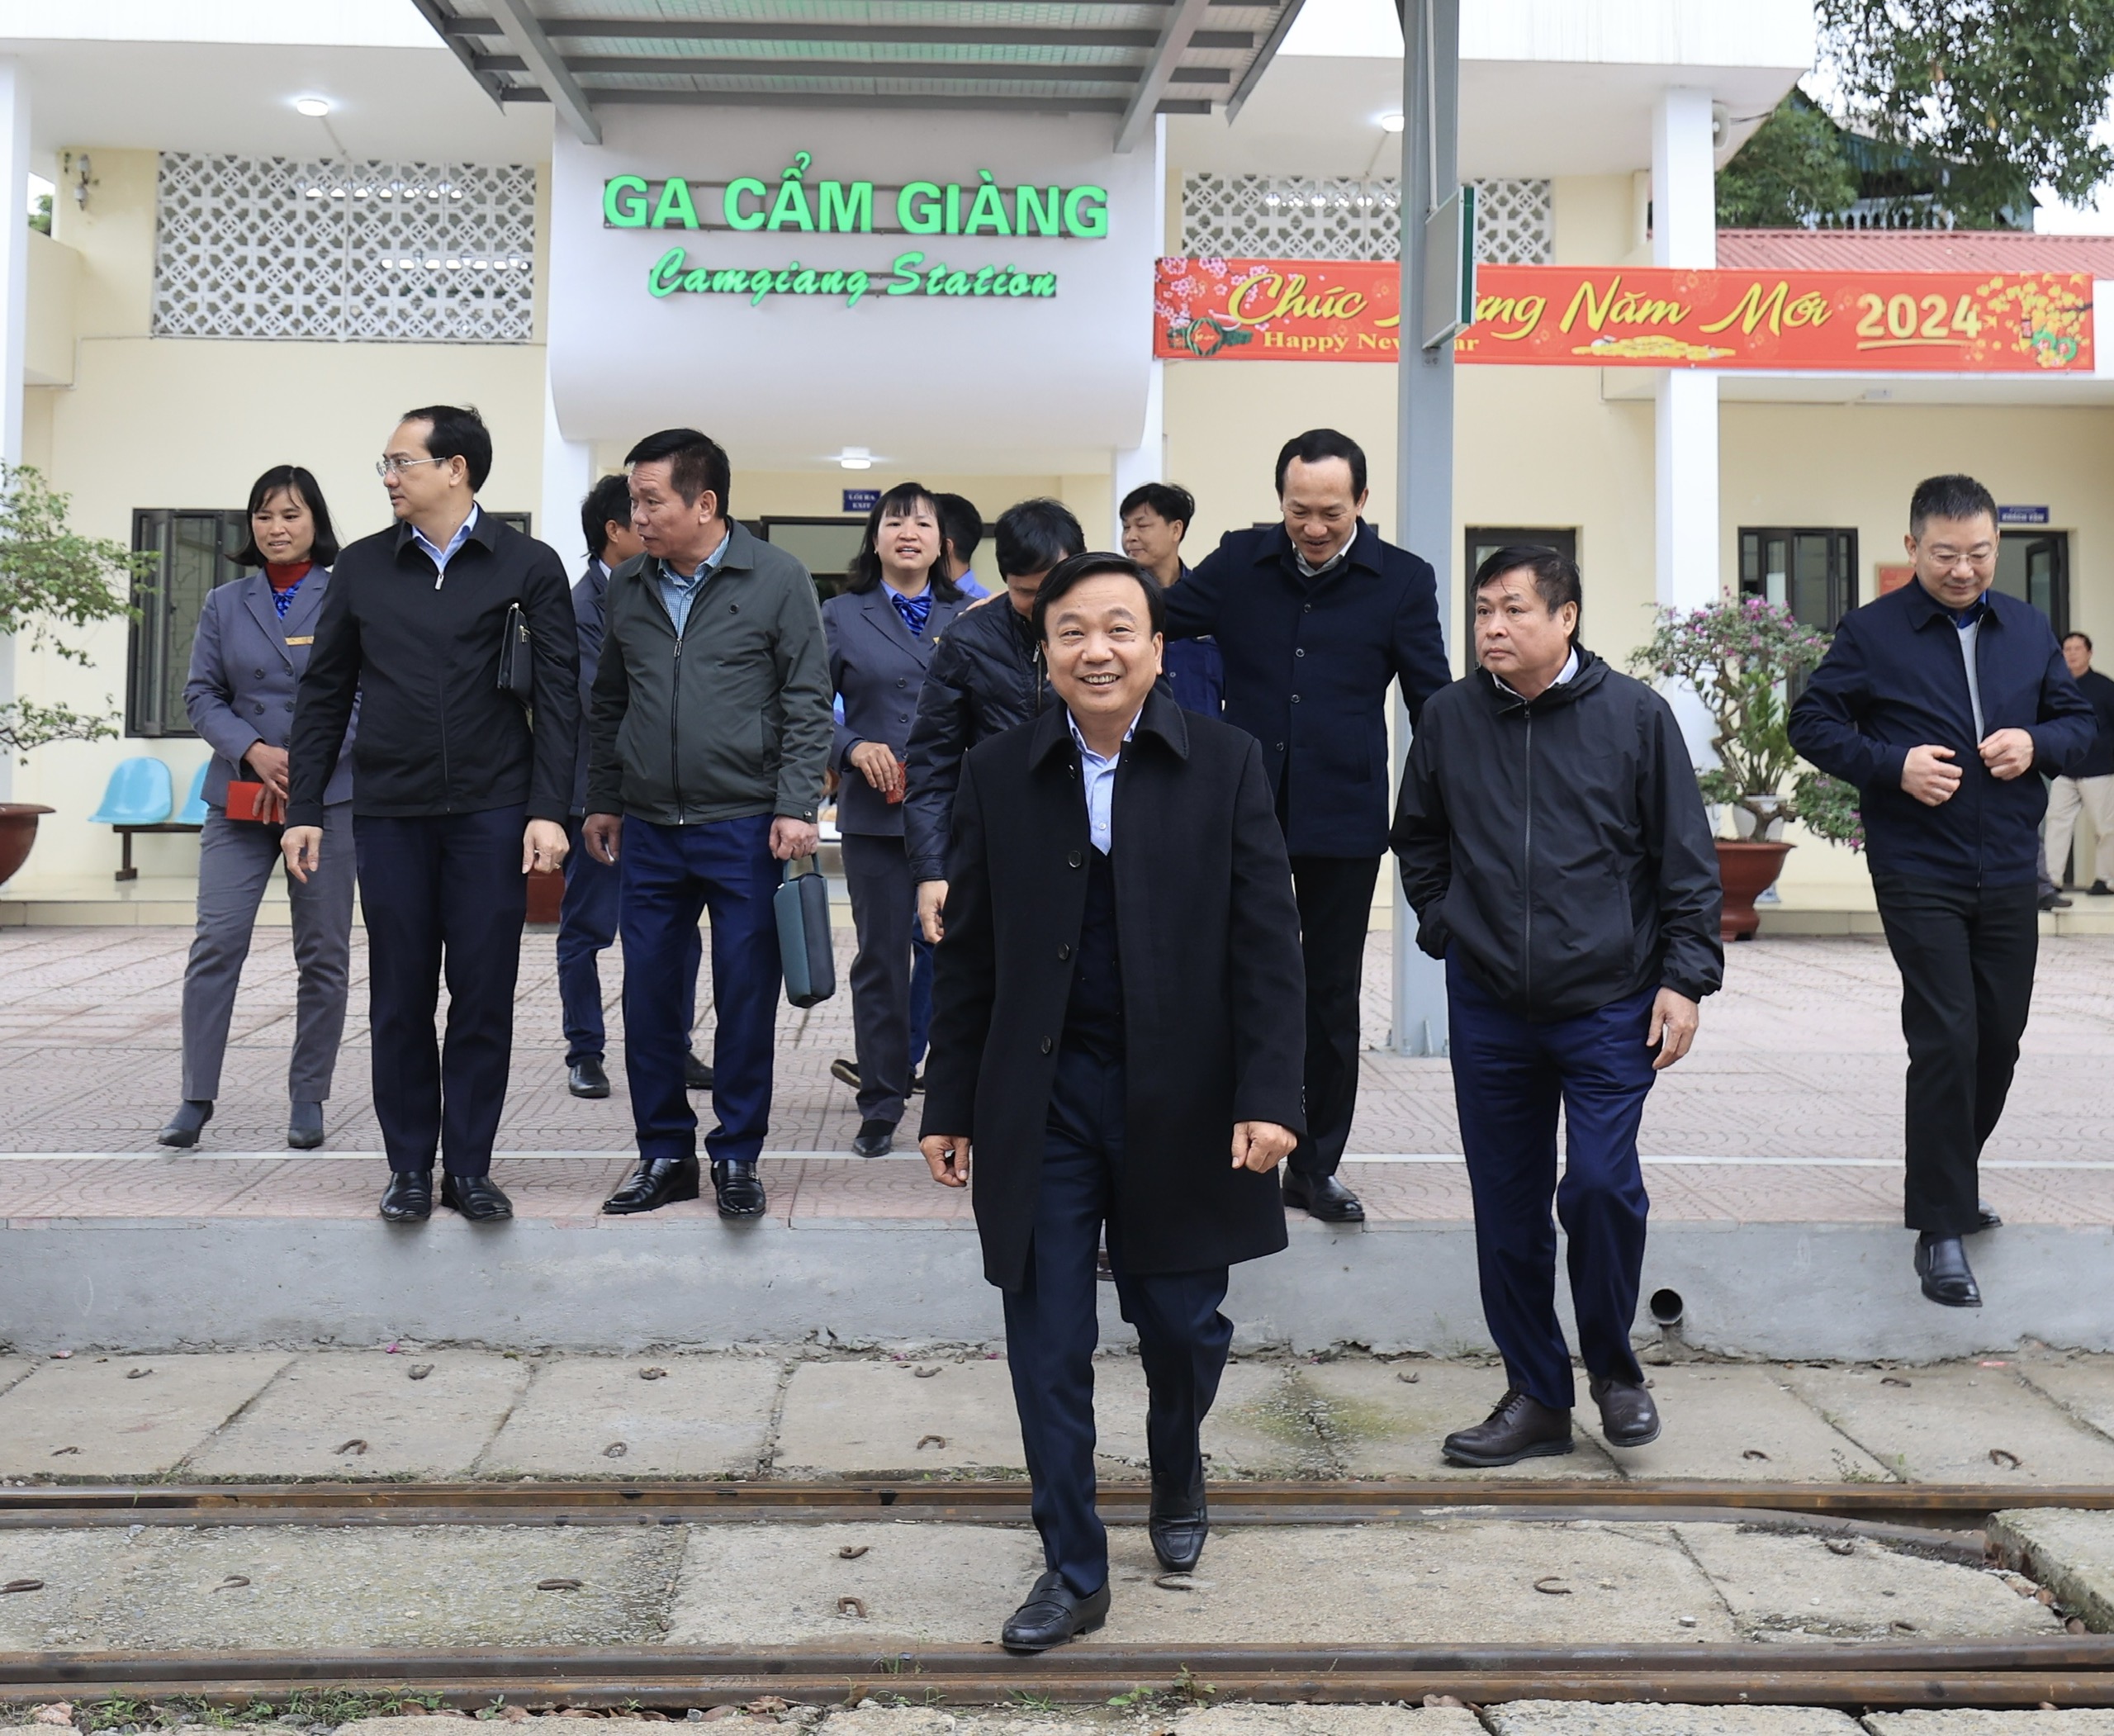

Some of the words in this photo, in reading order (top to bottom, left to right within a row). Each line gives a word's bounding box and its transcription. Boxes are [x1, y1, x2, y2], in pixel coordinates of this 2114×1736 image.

[603, 175, 699, 229] GA
[723, 150, 874, 232] CẨM
[896, 169, 1109, 238] GIÀNG
[647, 247, 871, 307] Camgiang
[886, 251, 1057, 297] Station
[1228, 273, 1368, 325] Chúc
[1373, 289, 1547, 340] ng
[1560, 275, 1691, 333] Năm
[1699, 281, 1832, 336] Mới
[1856, 292, 1981, 339] 2024
[1264, 331, 1349, 353] Happy
